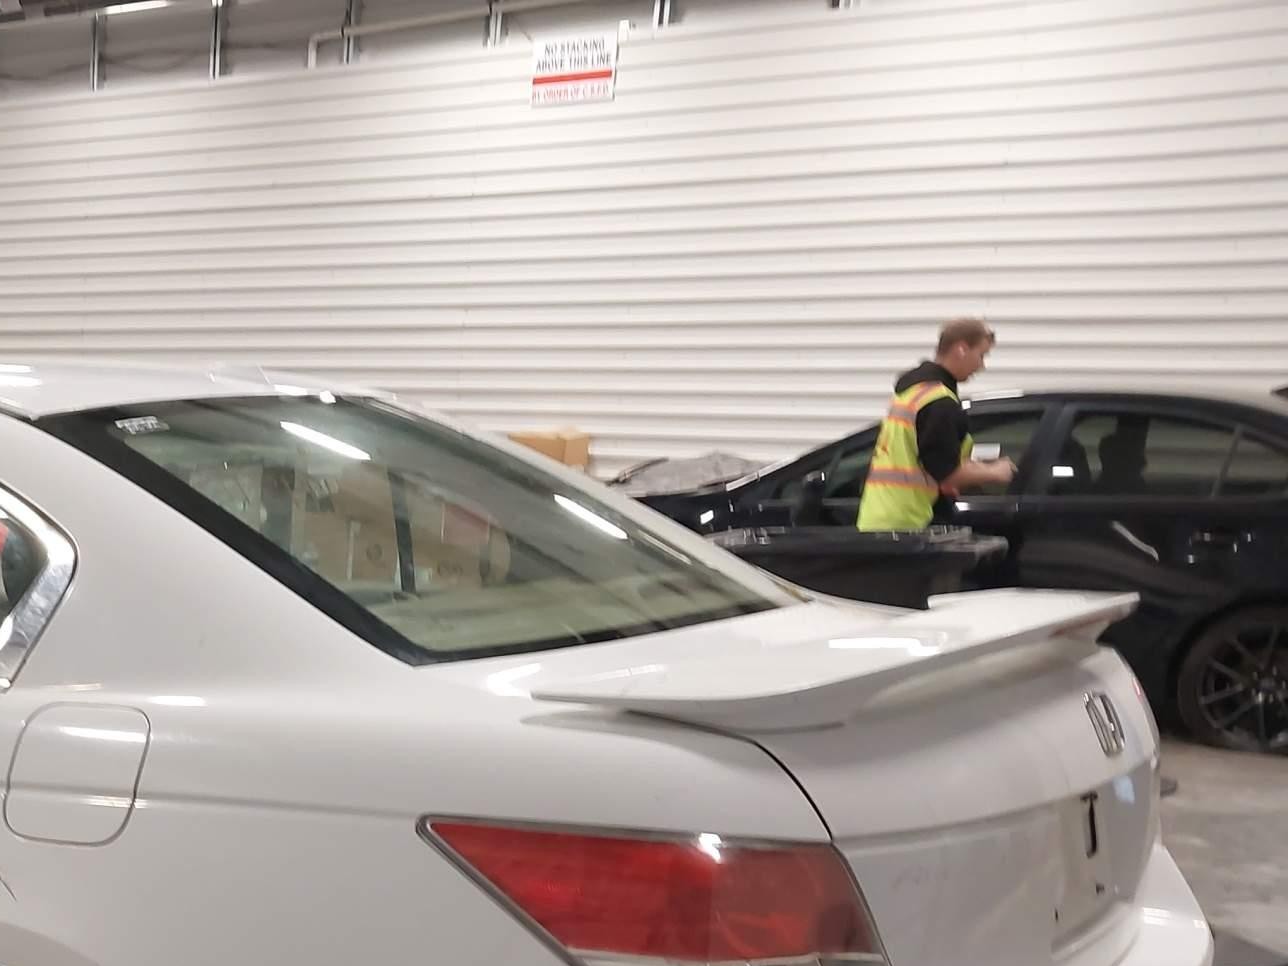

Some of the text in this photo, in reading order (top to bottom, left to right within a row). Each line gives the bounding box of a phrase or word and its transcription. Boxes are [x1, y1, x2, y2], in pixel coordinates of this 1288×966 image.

[544, 38, 605, 56] NO STACKING
[536, 53, 610, 72] ABOVE THIS LINE
